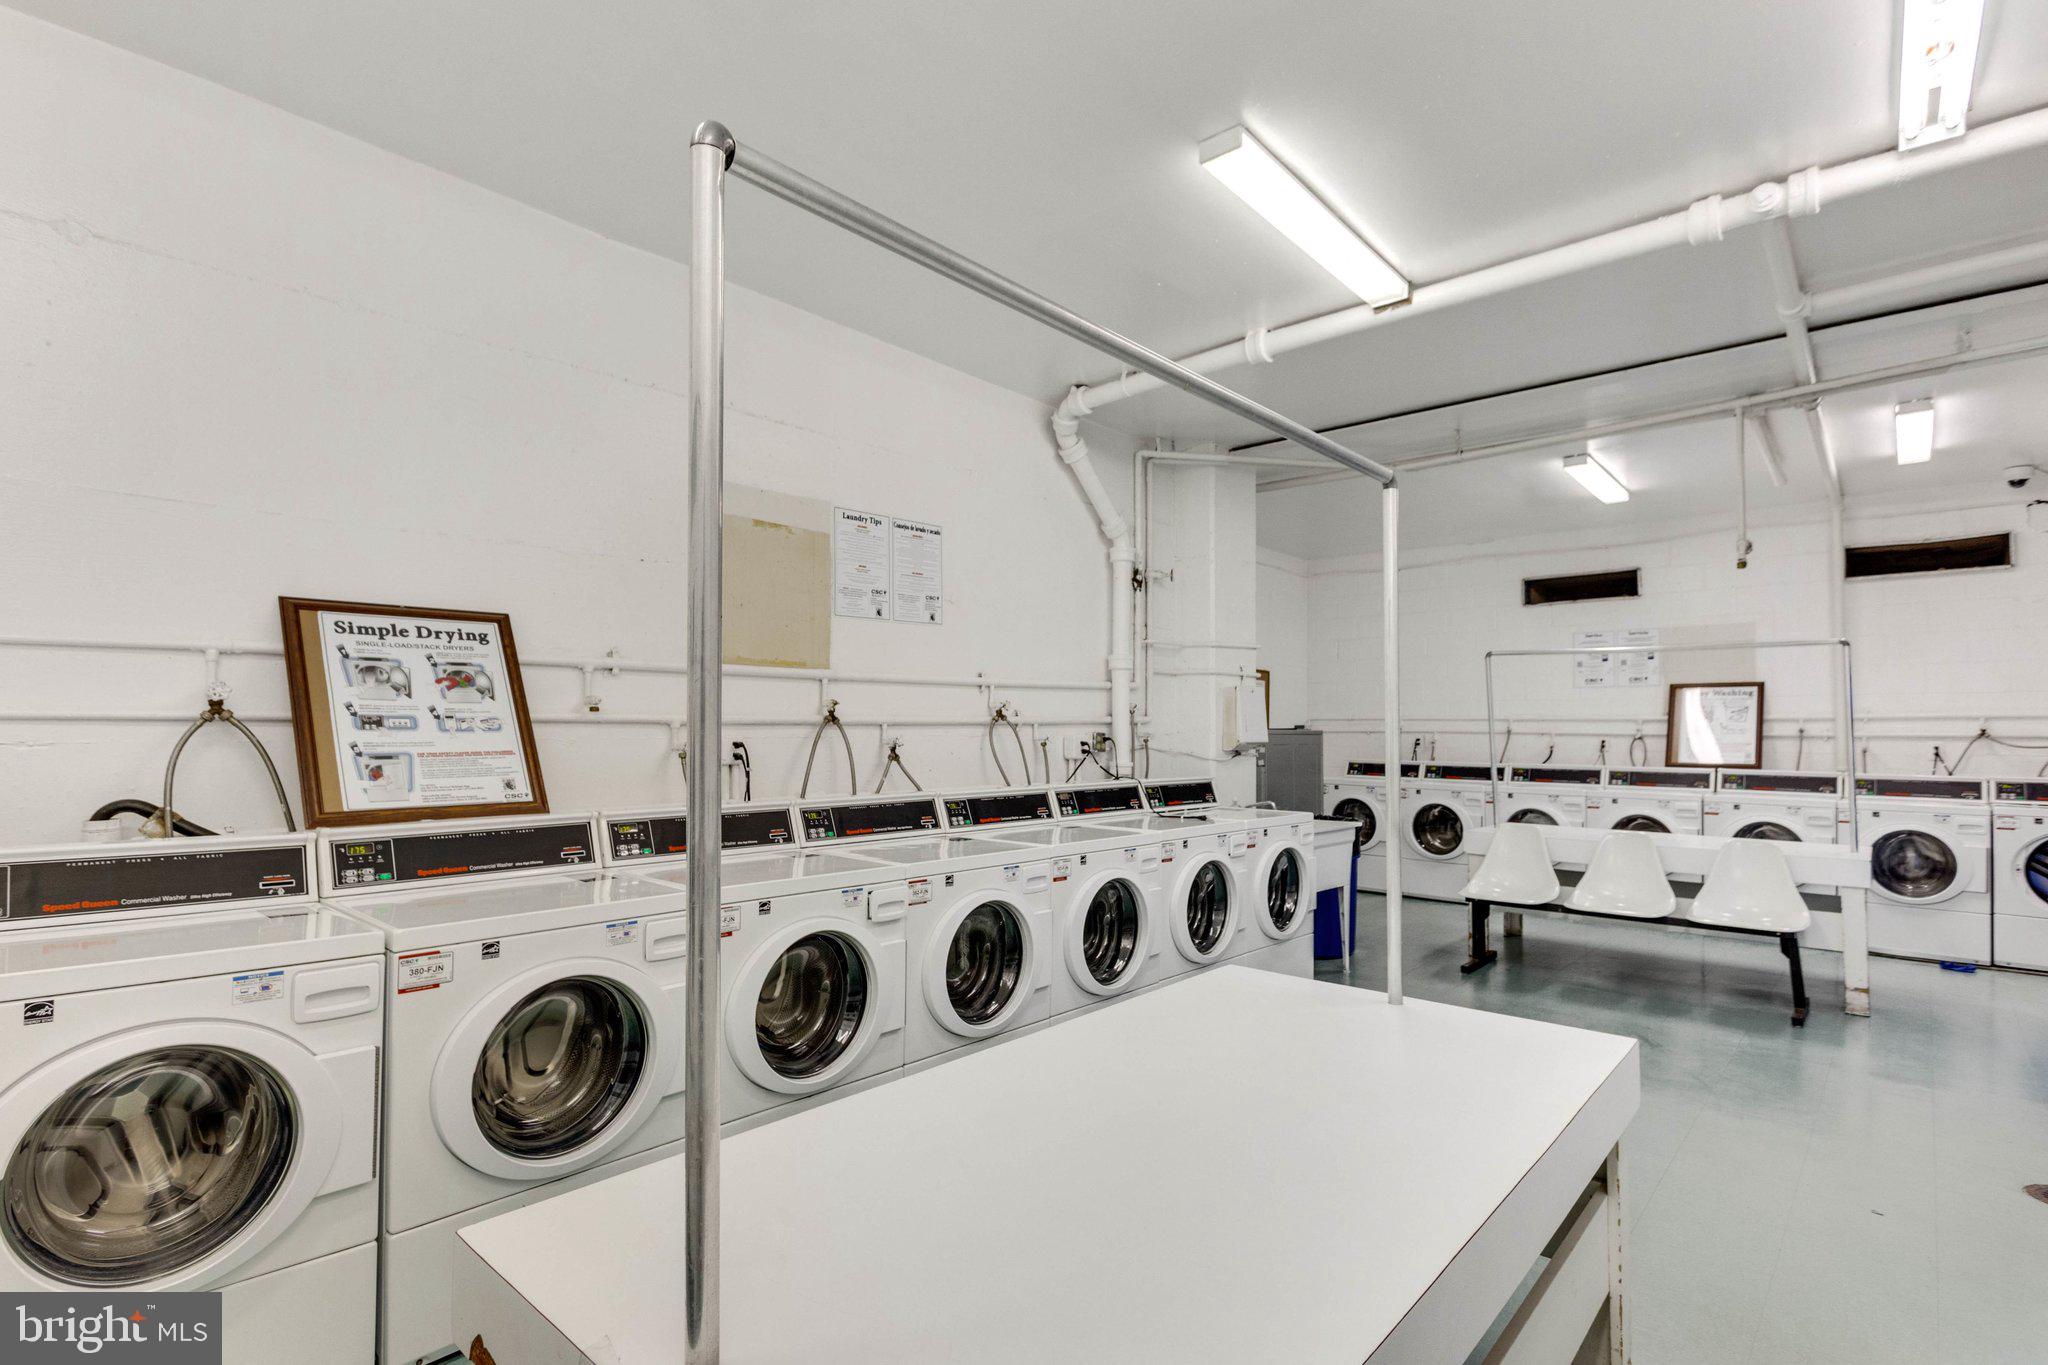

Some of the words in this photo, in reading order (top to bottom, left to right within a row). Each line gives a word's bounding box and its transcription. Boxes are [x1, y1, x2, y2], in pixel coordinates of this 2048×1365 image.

[842, 512, 868, 523] Laundry
[869, 517, 882, 526] Tips
[333, 620, 410, 640] Simple
[415, 625, 490, 646] Drying
[66, 858, 116, 867] PERMANENT
[469, 863, 496, 871] Commercial
[42, 903, 81, 913] Speed
[82, 899, 119, 909] Queen
[121, 893, 161, 906] Commercial
[162, 893, 187, 902] Washer
[408, 964, 444, 977] 380-FJN
